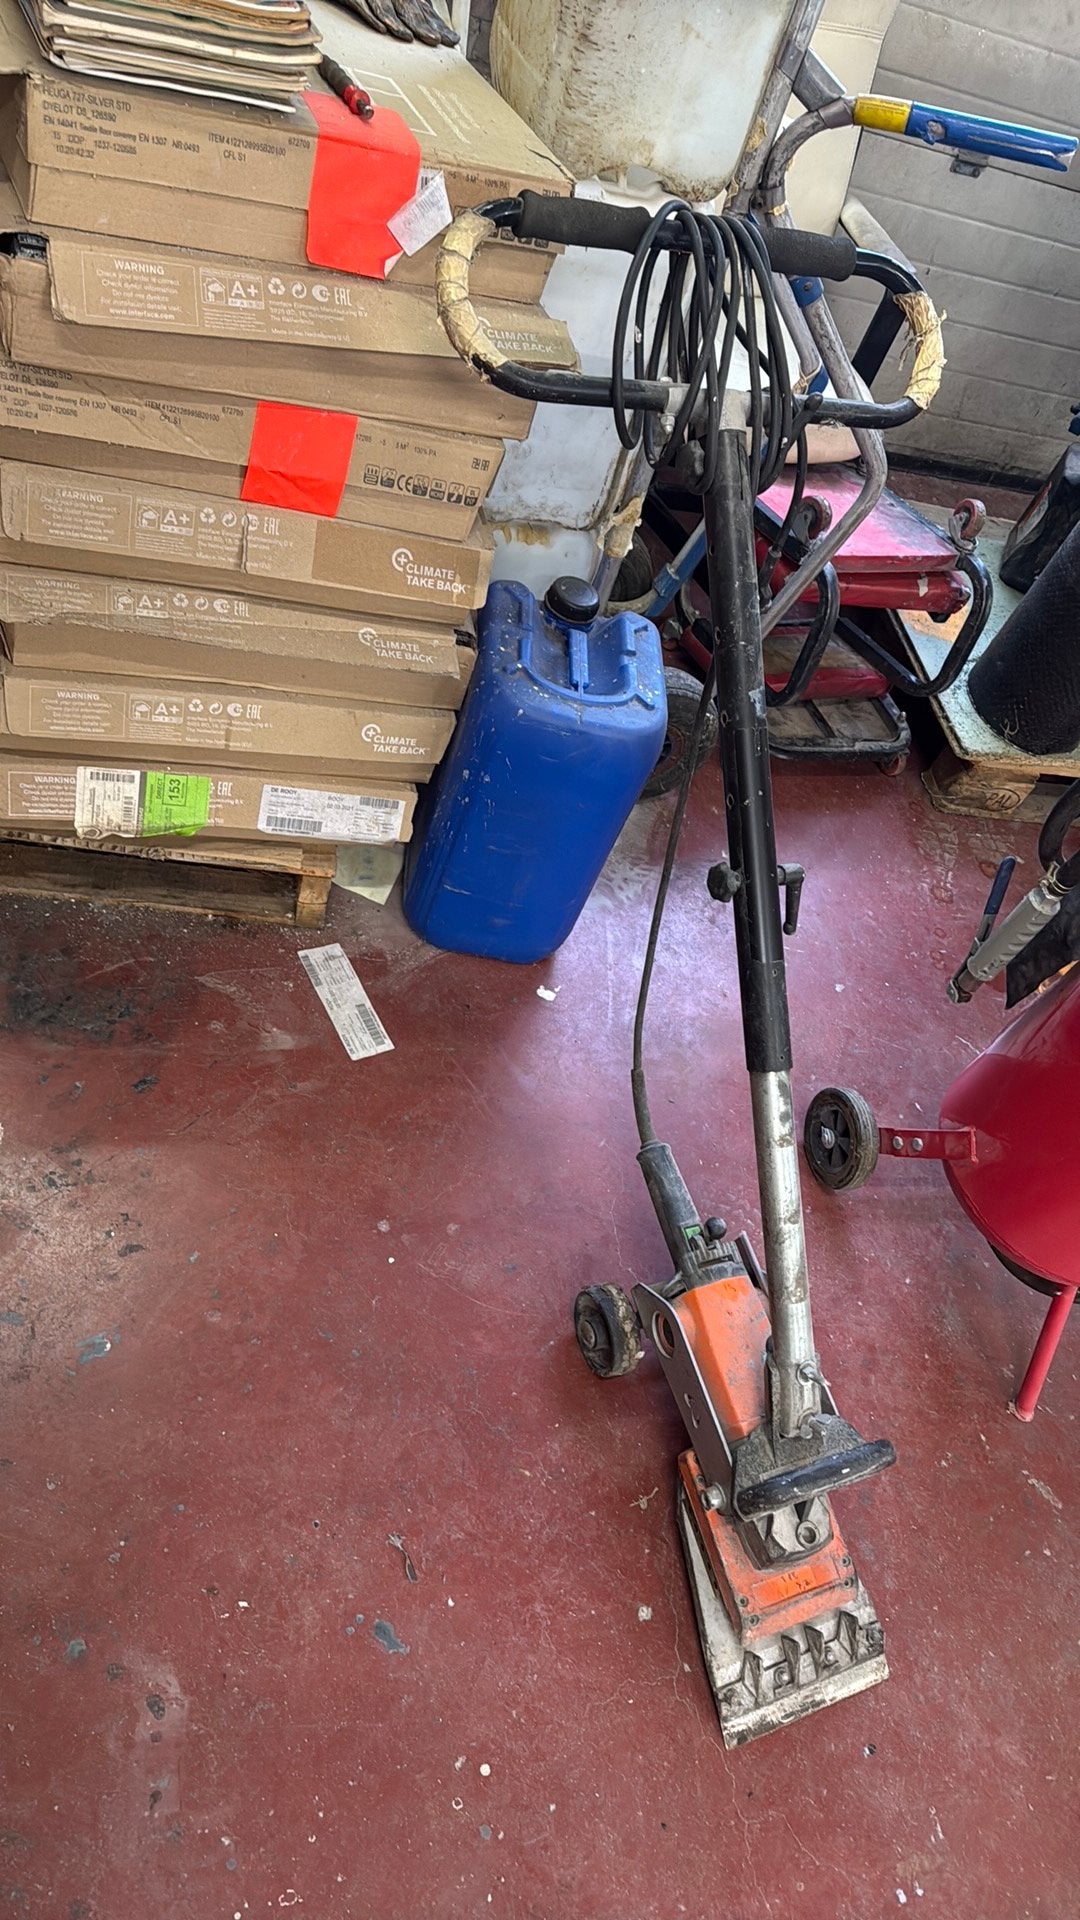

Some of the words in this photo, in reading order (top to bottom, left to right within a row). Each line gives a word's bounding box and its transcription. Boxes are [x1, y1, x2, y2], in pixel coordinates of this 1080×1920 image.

[116, 100, 132, 112] STD
[139, 132, 150, 144] EN
[208, 132, 226, 145] ITEM
[113, 259, 165, 276] WARNING
[231, 280, 259, 298] A+
[486, 328, 538, 342] CLIMATE
[523, 342, 555, 354] BACK
[164, 509, 190, 525] A+
[406, 563, 455, 580] CLIMATE
[35, 579, 81, 590] WARNING
[406, 574, 435, 589] TAKE
[436, 580, 467, 595] BACK
[373, 639, 420, 653] CLIMATE
[375, 648, 403, 660] TAKE
[404, 653, 434, 664] BACK
[56, 690, 100, 701] WARNING
[154, 702, 180, 715] A+
[373, 735, 417, 746] CLIMATE
[373, 744, 398, 754] TAKE
[400, 747, 426, 755] BACK
[34, 775, 76, 785] WARNING
[168, 778, 181, 801] 153
